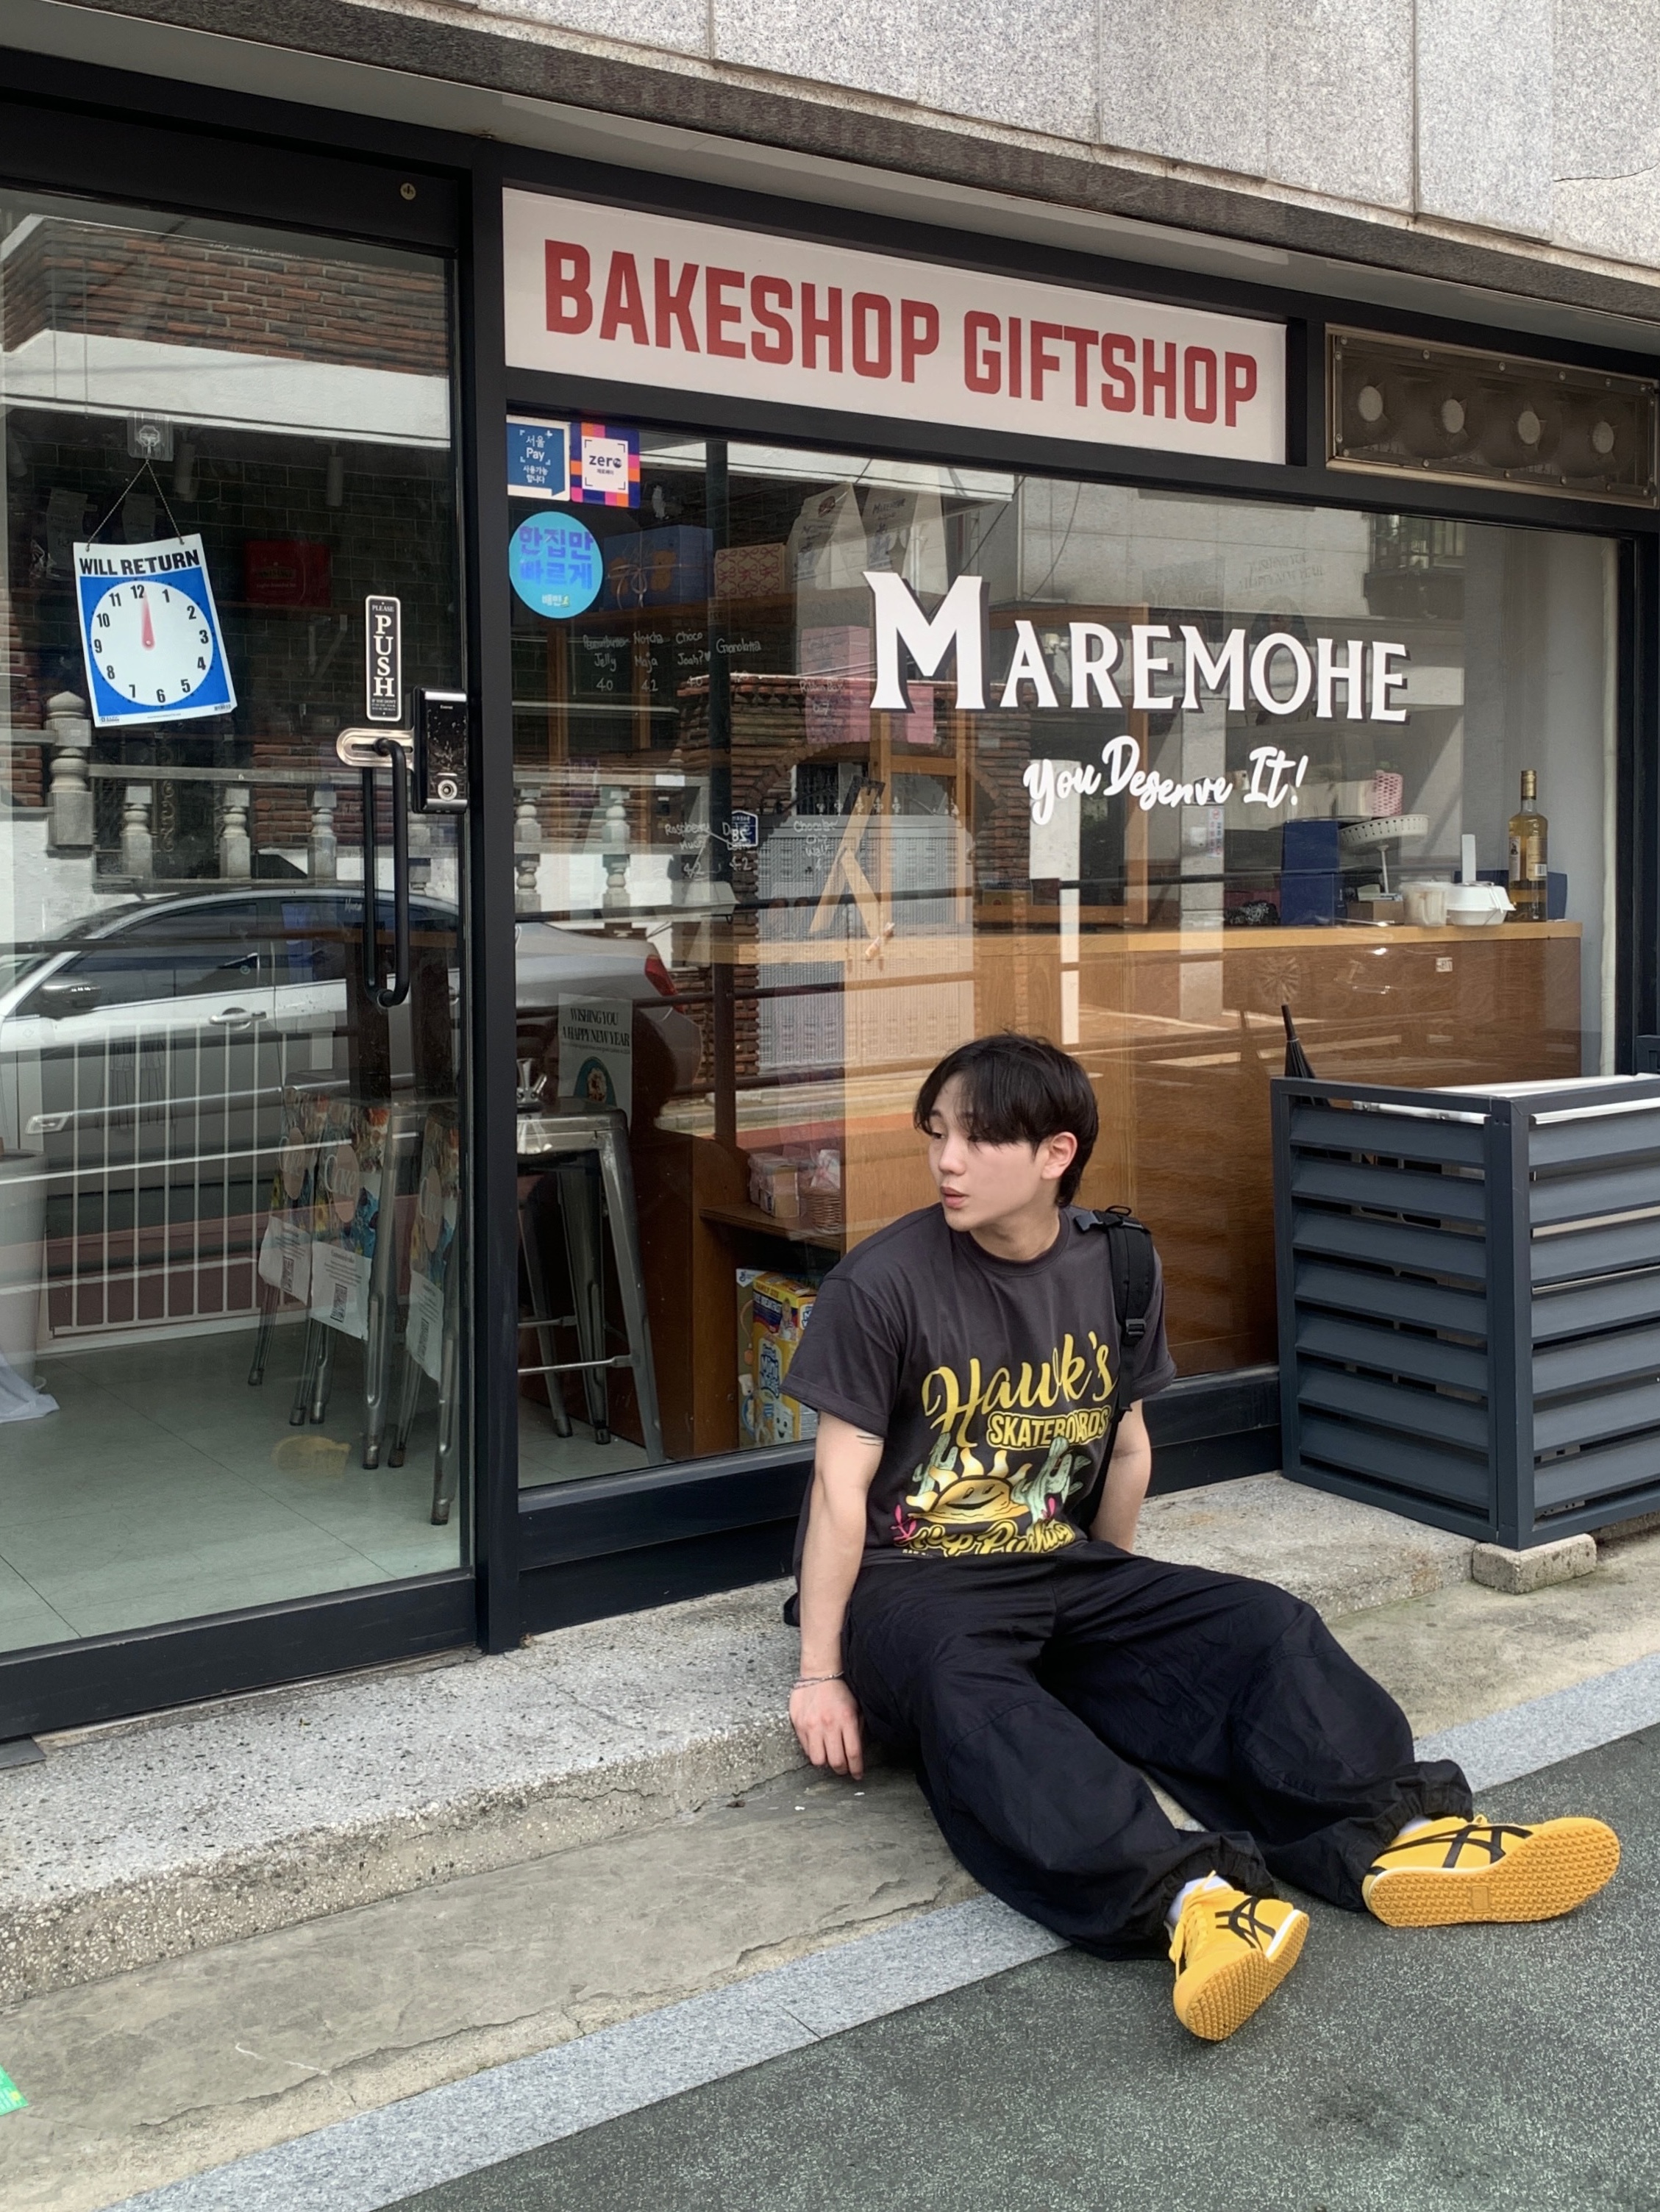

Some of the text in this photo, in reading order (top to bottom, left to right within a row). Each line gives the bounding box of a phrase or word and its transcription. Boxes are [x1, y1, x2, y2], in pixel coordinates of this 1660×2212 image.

[544, 238, 1258, 427] BAKESHOP GIFTSHOP
[525, 435, 546, 448] 서울
[526, 447, 545, 462] Pay
[523, 465, 549, 476] 사용가능
[526, 474, 546, 485] 합니다
[519, 526, 594, 560] 한집만
[79, 549, 200, 575] WILL RETURN
[519, 560, 593, 590] 빠르게
[130, 585, 145, 599] 12
[162, 589, 170, 603] 1
[109, 593, 121, 607] 11
[187, 605, 196, 620] 2
[371, 604, 394, 613] PLEASE
[96, 613, 110, 627] 10
[199, 629, 209, 644] 3
[676, 630, 703, 644] Choco
[93, 639, 102, 654] 9
[863, 571, 1410, 723] MAREMOHE
[373, 615, 395, 697] PUSH
[594, 652, 616, 671] Jelly
[197, 657, 206, 671] 4
[106, 665, 115, 679] 8
[129, 684, 136, 699] 7
[180, 679, 191, 693] 5
[156, 689, 165, 703] 6
[1023, 735, 1309, 825] You Deserve It!
[602, 1011, 619, 1026] YOU
[922, 1331, 1119, 1448] Hawk's
